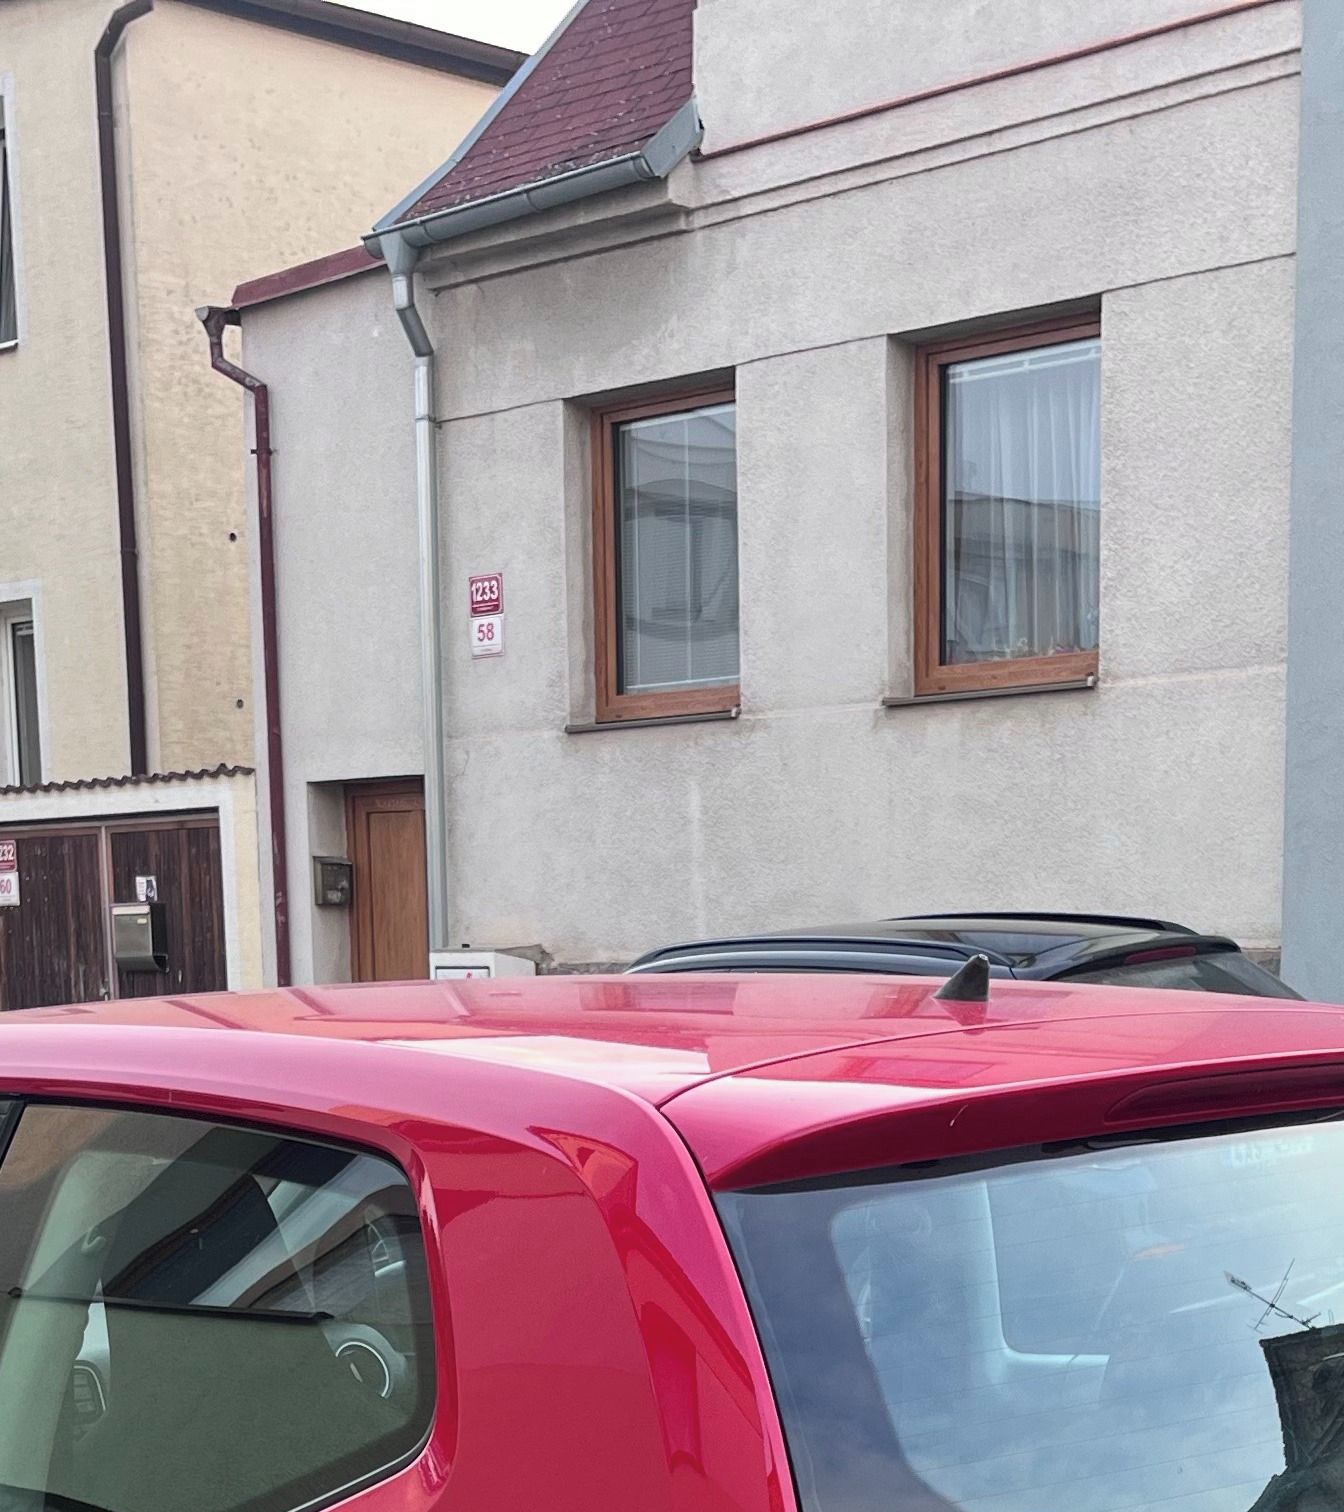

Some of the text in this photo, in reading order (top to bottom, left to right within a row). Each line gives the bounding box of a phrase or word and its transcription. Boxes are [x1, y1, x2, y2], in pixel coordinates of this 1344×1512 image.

[471, 580, 499, 602] 1233
[477, 622, 495, 642] 58
[0, 878, 12, 894] 60
